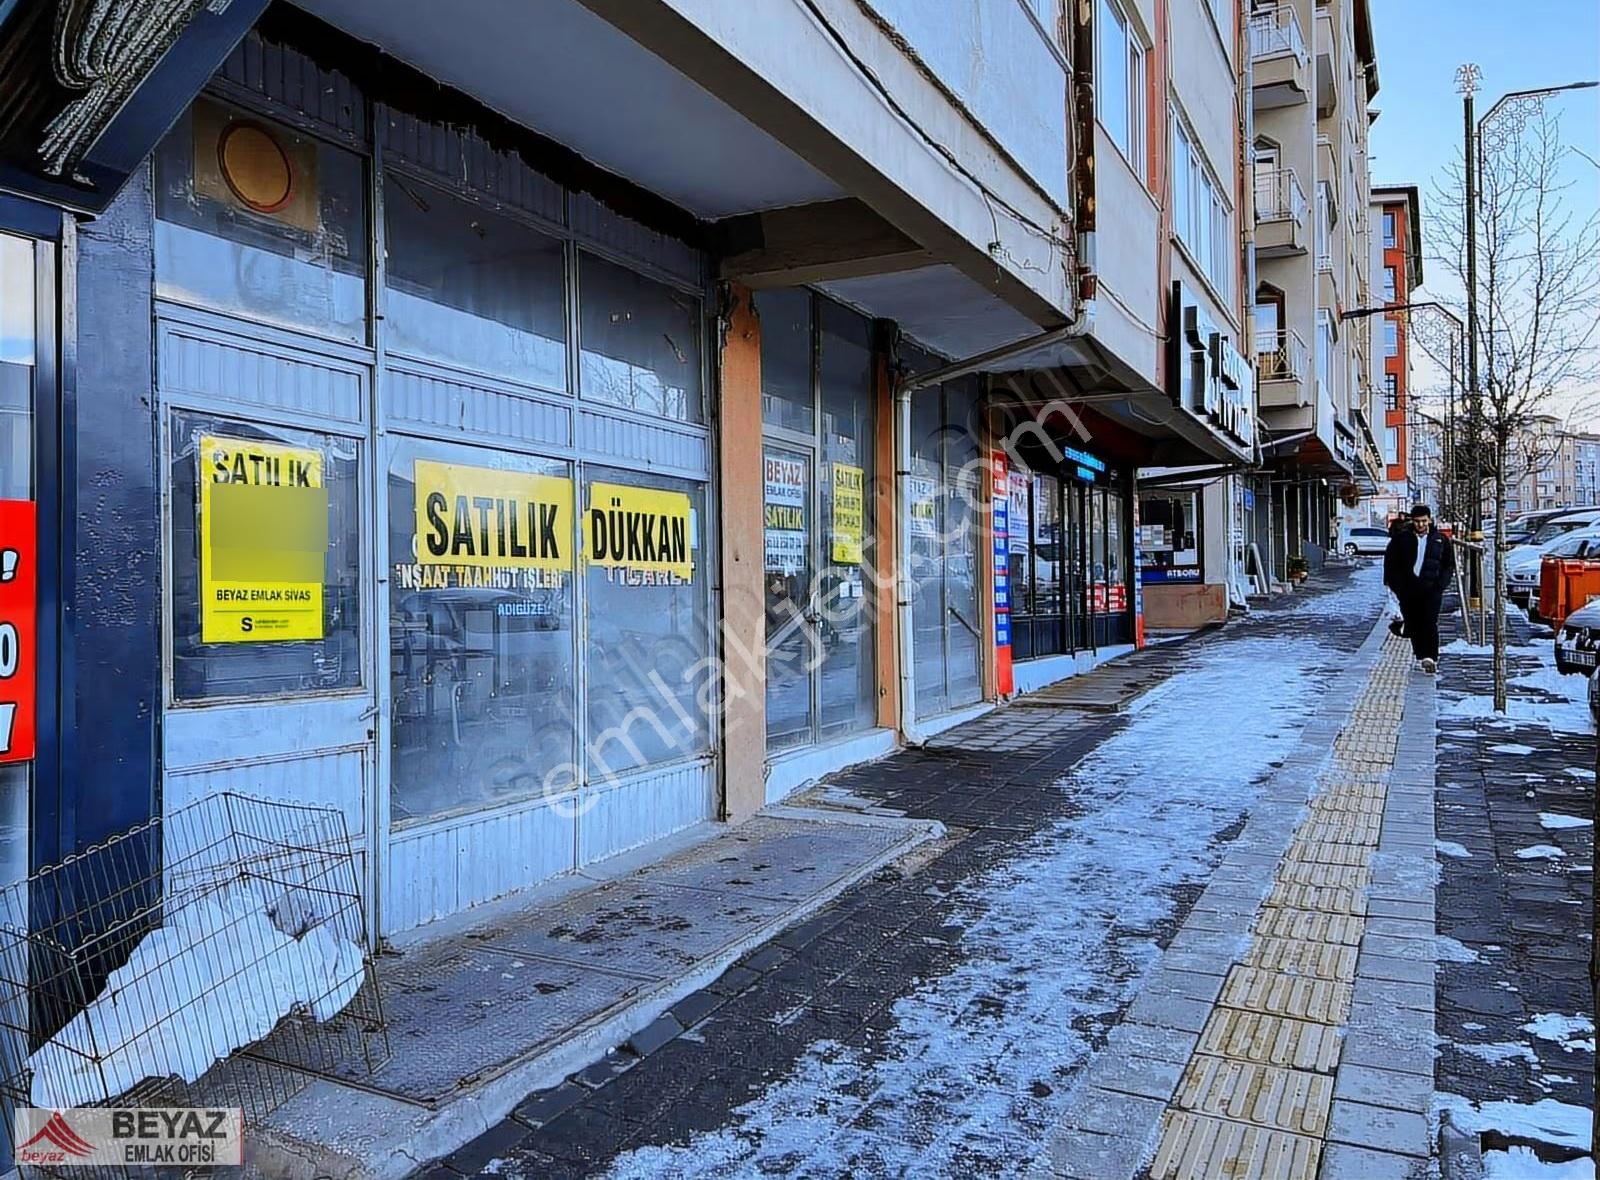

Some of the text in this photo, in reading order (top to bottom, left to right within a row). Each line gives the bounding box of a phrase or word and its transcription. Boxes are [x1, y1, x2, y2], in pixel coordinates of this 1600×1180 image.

[766, 461, 801, 486] BEYAZ
[836, 469, 860, 491] SATILIK
[426, 492, 559, 559] SATILIK
[591, 498, 685, 562] DÜKKAN
[765, 505, 804, 530] SATILIK
[216, 589, 311, 601] BEYAZ EMLAK SİVAS
